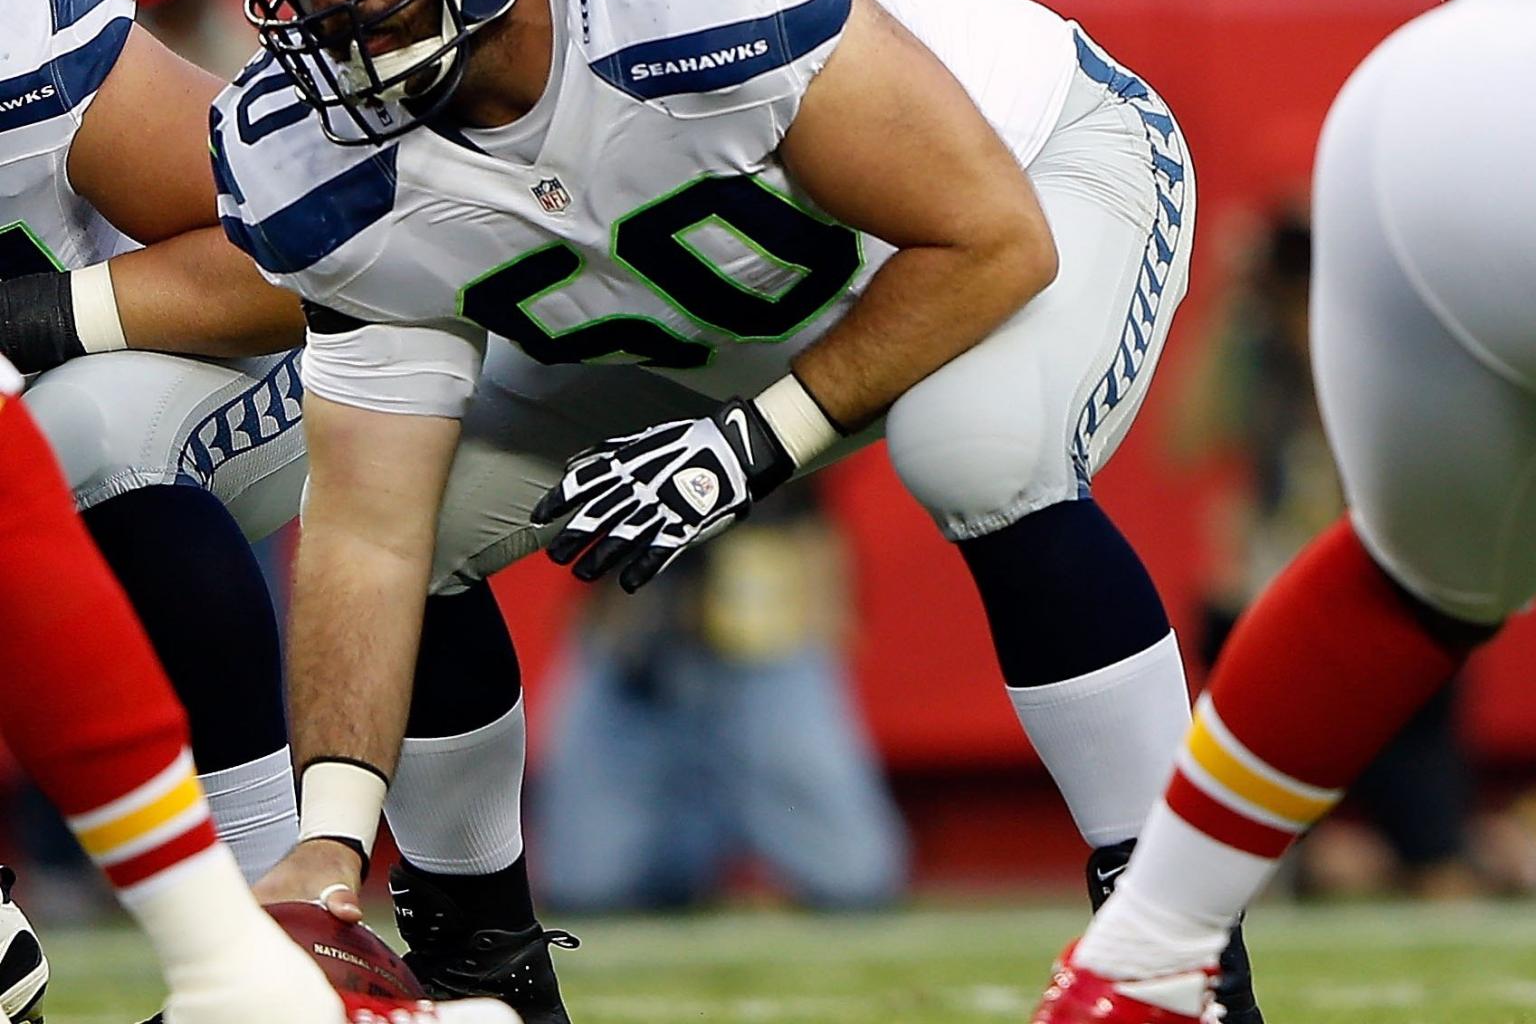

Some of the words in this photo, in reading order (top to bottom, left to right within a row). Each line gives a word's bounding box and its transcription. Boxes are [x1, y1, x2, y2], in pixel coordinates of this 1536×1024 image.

[630, 39, 769, 81] SEAHAWKS
[540, 190, 568, 210] NFL
[456, 173, 867, 370] 60
[313, 943, 372, 971] NATIONAL
